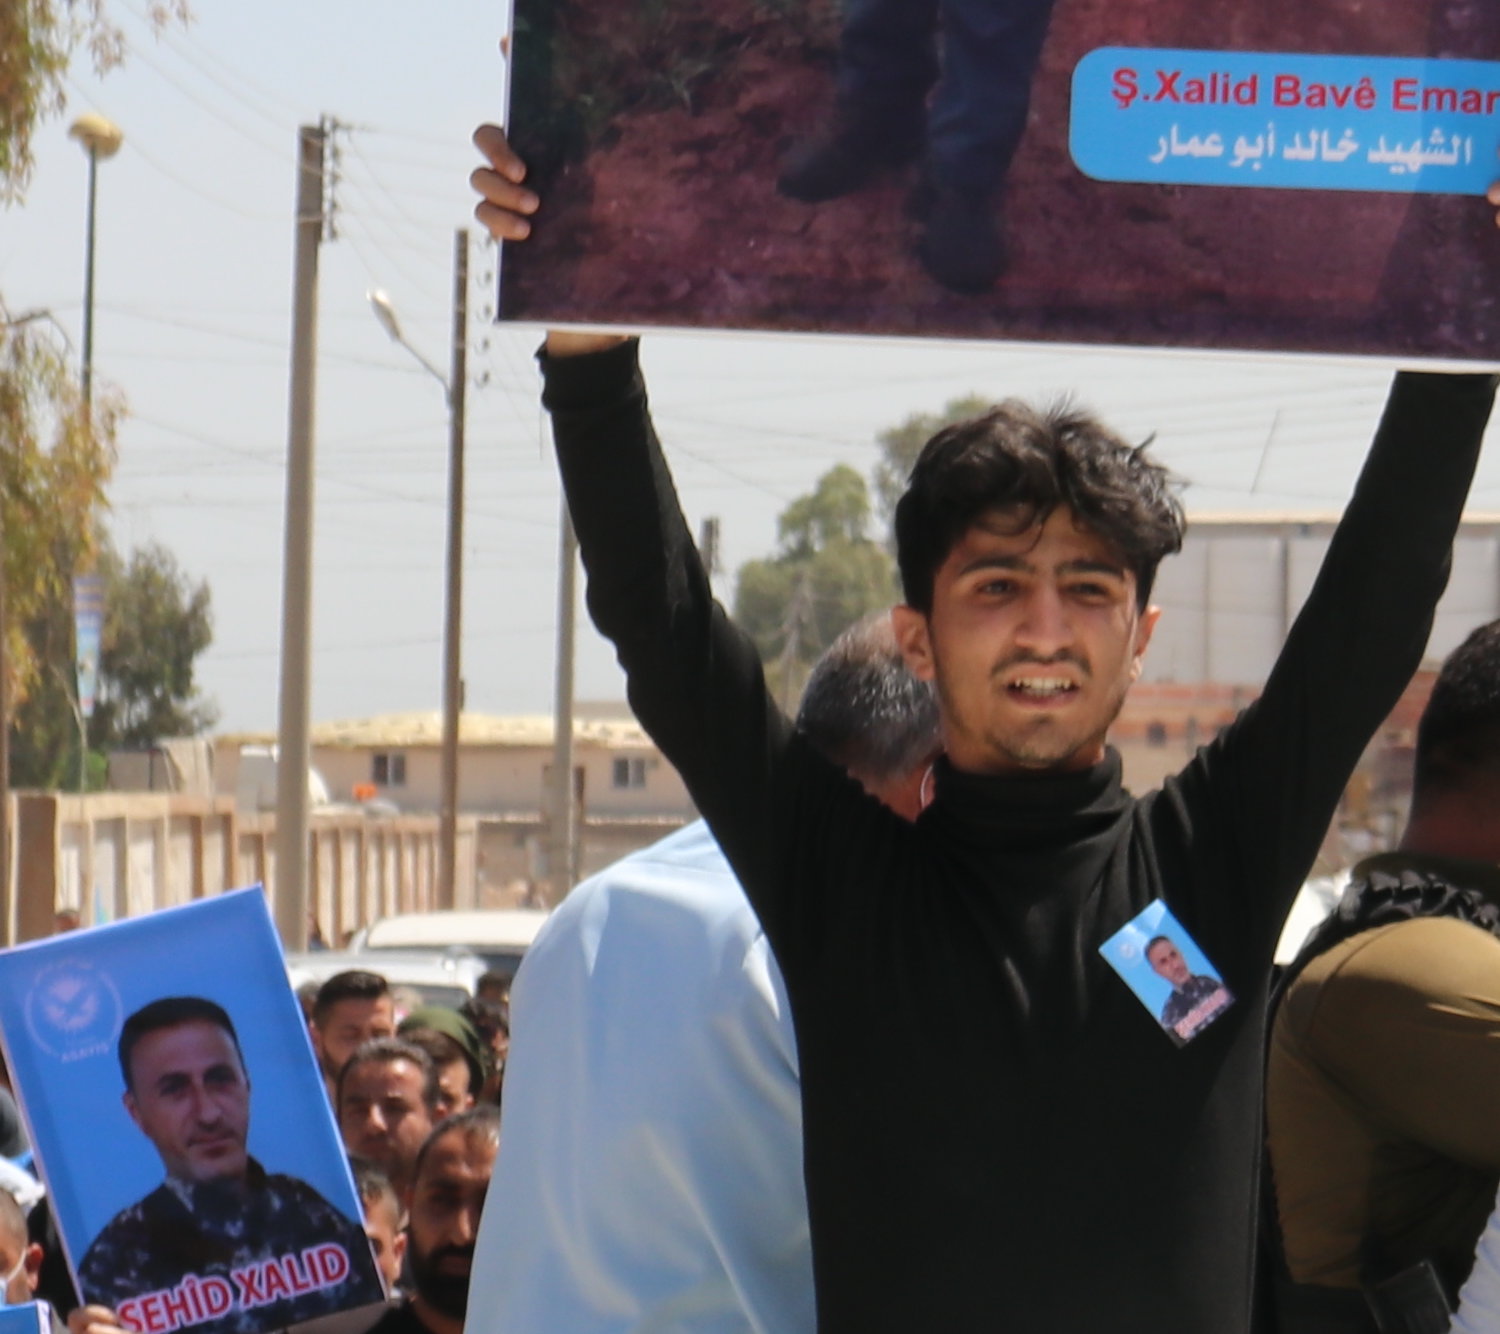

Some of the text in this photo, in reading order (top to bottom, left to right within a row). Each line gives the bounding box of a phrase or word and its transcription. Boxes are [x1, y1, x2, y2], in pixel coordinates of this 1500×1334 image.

[1110, 67, 1259, 109] Ş.Xalid
[1272, 74, 1378, 110] Bavê
[1149, 122, 1474, 174] الشهيد خالد أبو عمار
[233, 1245, 349, 1306] XALID
